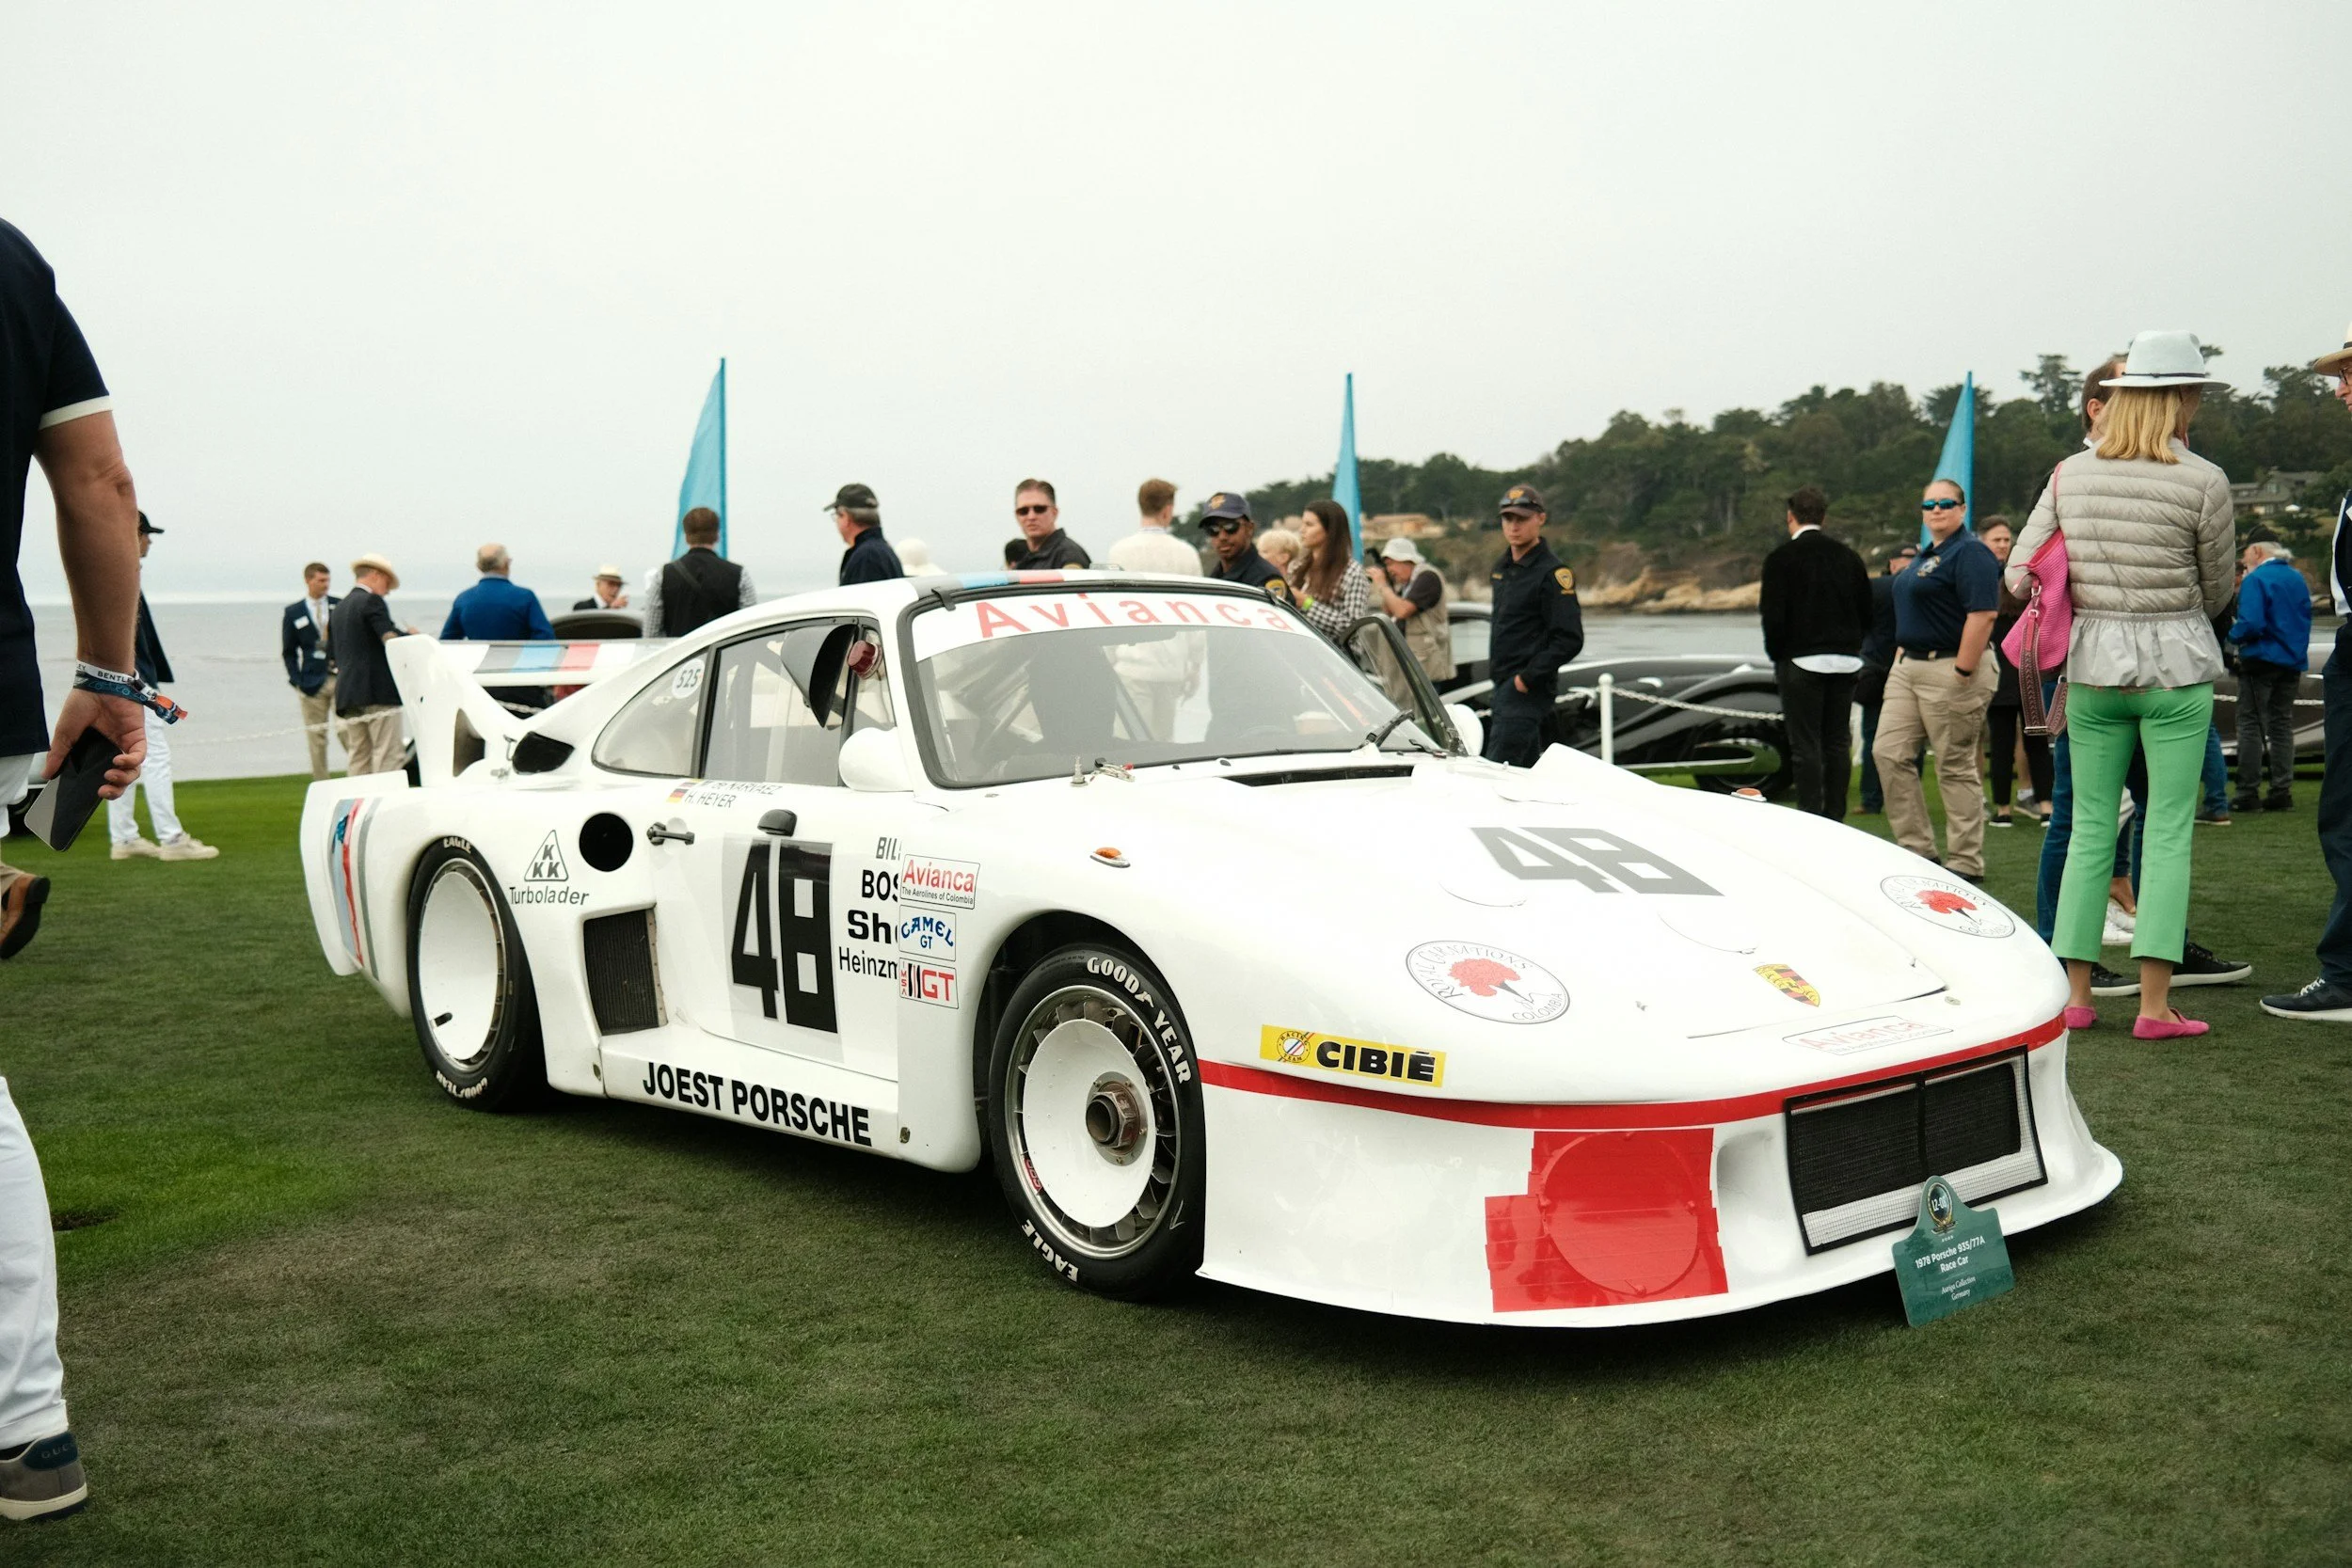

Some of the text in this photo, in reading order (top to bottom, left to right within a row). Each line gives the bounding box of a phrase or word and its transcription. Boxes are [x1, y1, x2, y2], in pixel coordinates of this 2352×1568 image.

[975, 593, 1296, 639] Avianca
[97, 671, 135, 683] BENTLE
[676, 668, 701, 689] 525
[697, 792, 737, 808] HEYER
[876, 836, 902, 861] BIL
[1470, 826, 1725, 896] 48
[903, 859, 976, 893] Avianca
[509, 886, 590, 906] Turbolader
[902, 886, 912, 896] The
[939, 891, 946, 900] of
[946, 893, 974, 905] Colombia
[731, 838, 838, 1034] 48
[848, 909, 898, 944] Sh
[900, 916, 954, 947] CAMEL
[920, 934, 932, 949] GT
[1418, 944, 1534, 970] CARNATIONS
[922, 969, 954, 1001] GT
[1512, 992, 1564, 1022] COLOMBIA
[1280, 1032, 1309, 1045] RACING
[1798, 1021, 1925, 1050] Avianca
[1283, 1053, 1302, 1062] TEAM
[1316, 1041, 1436, 1082] CIBIÉ
[643, 1062, 872, 1147] JOEST PORSCHE
[1022, 1218, 1080, 1283] EAGLE
[1915, 1255, 1931, 1269] 1978
[1931, 1246, 1958, 1263] Porsche
[1957, 1235, 1986, 1254] 935/77A
[1940, 1255, 1969, 1273] Race Car
